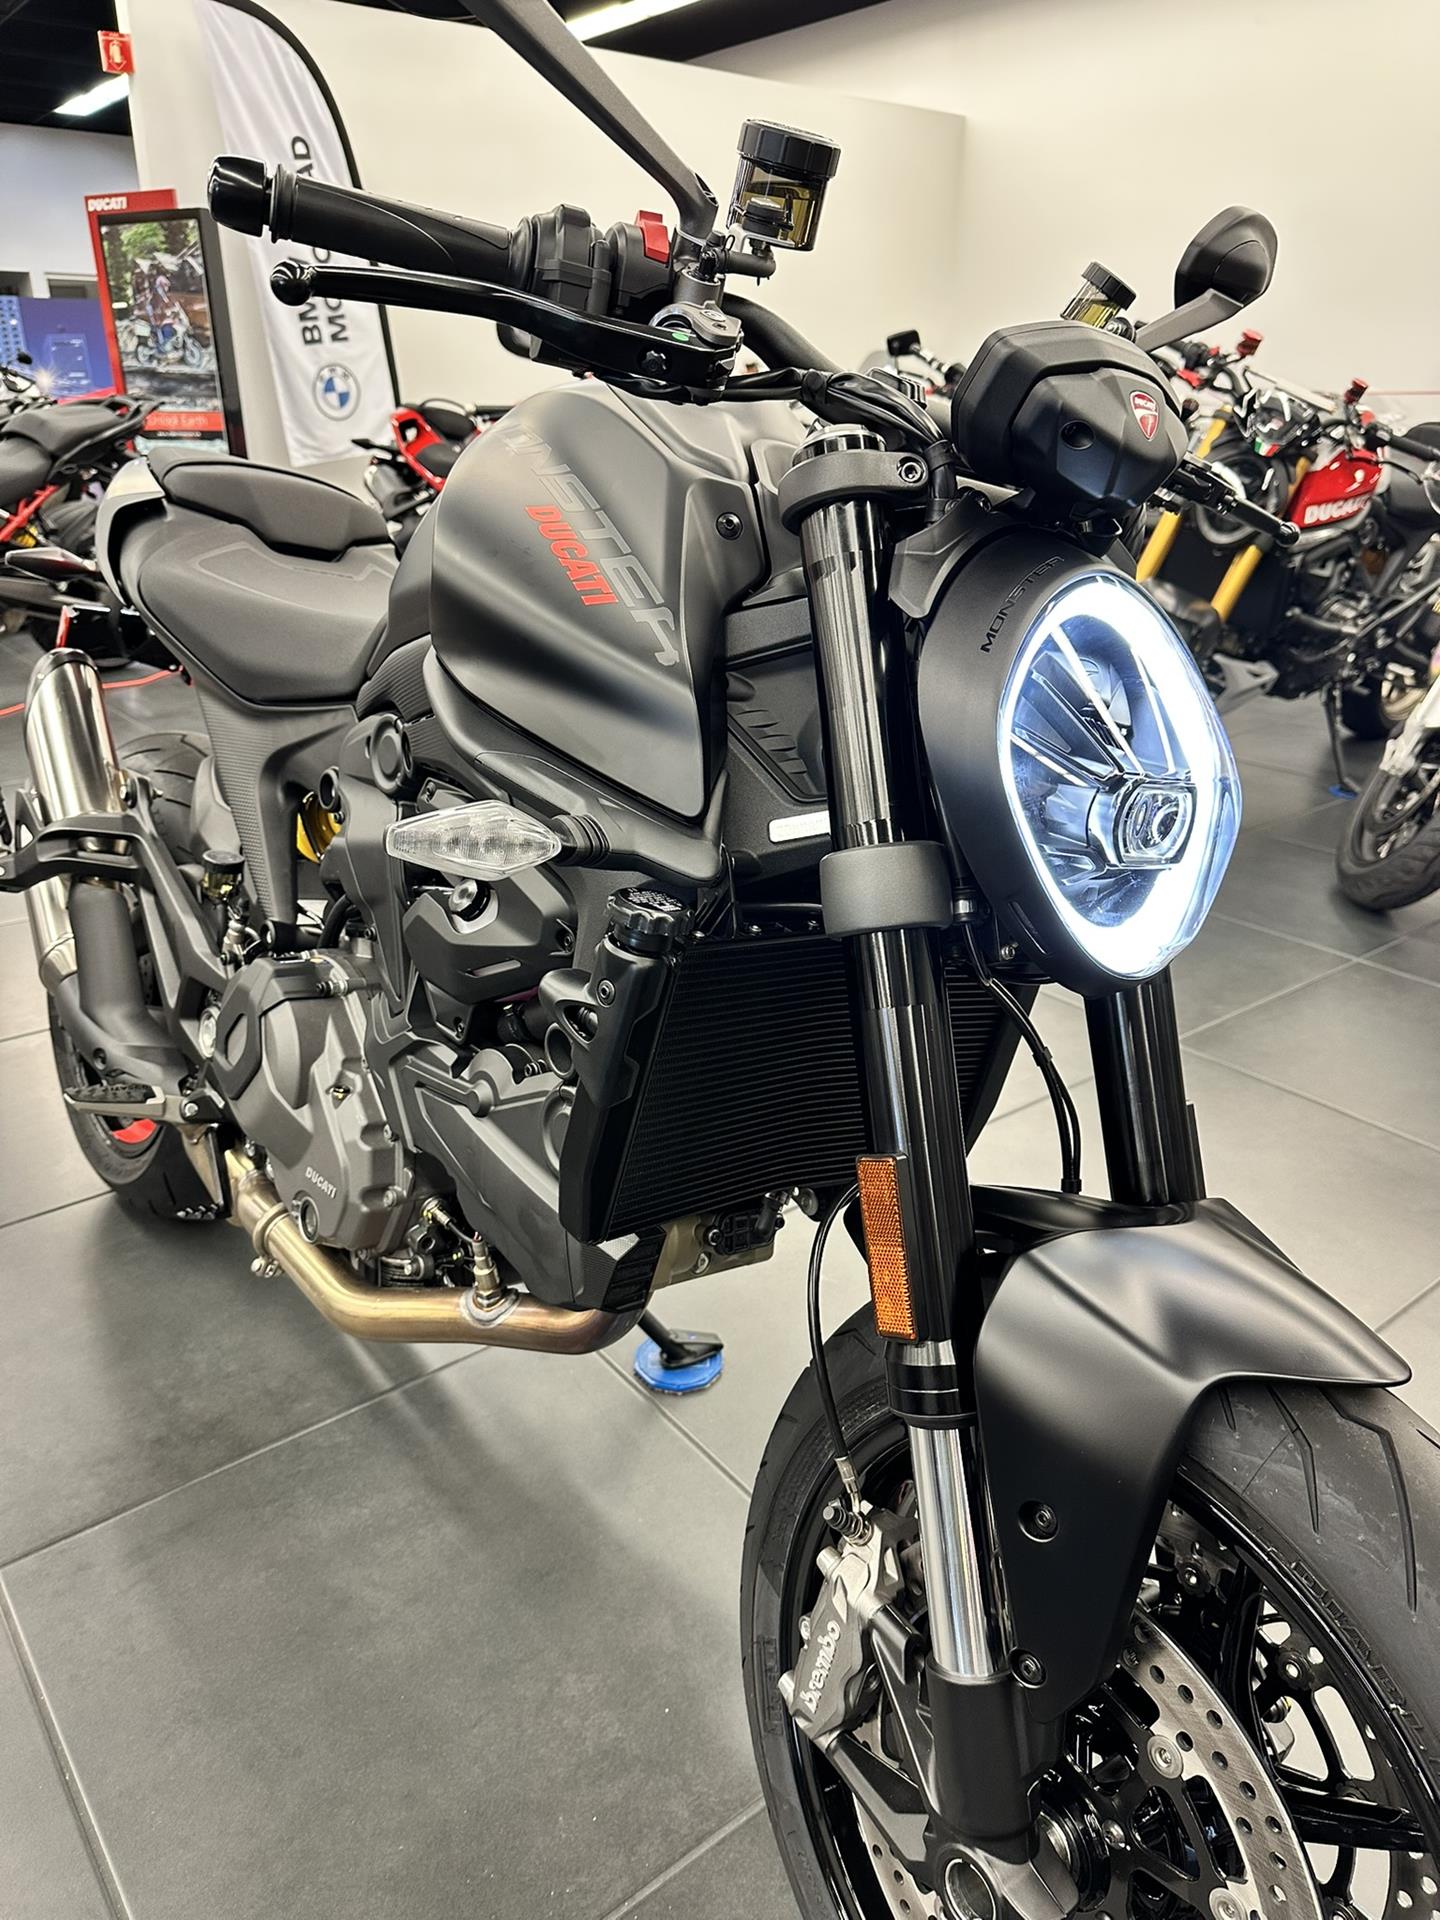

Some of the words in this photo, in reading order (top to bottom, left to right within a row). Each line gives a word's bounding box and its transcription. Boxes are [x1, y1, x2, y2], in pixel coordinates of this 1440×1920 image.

[87, 196, 128, 212] DUCATI
[524, 503, 619, 606] DUCATI
[980, 555, 1065, 653] MONSTER
[305, 1166, 337, 1198] DUCATI
[800, 1620, 841, 1714] brembo
